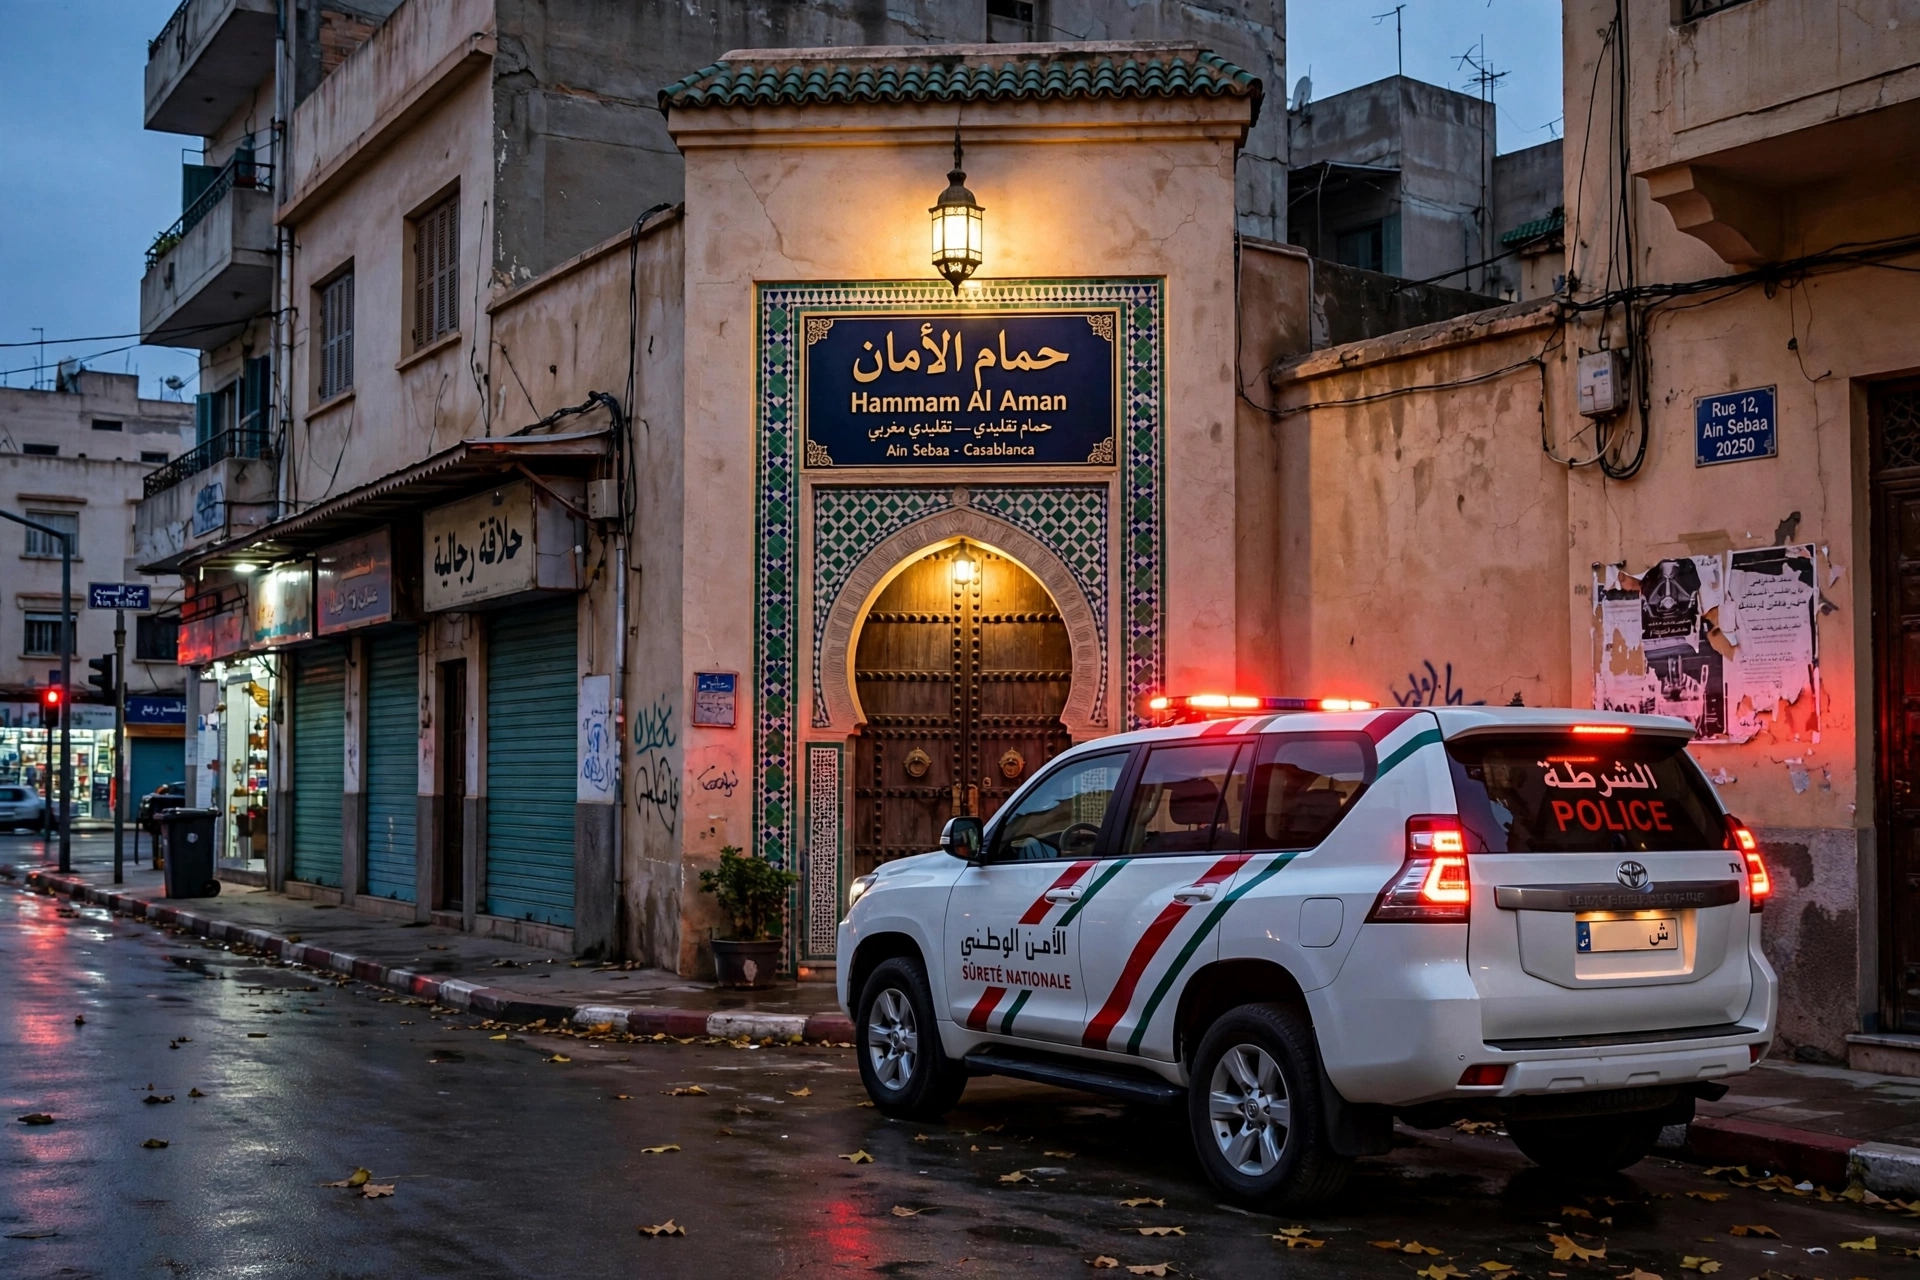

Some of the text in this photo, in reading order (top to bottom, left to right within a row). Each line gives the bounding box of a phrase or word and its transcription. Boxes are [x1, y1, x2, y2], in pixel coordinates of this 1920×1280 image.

[852, 322, 1070, 390] حمام الأمان
[851, 389, 1067, 413] Hammam Al Aman
[1712, 396, 1759, 418] Rue 12,
[868, 421, 905, 442] مغربي
[908, 419, 952, 439] تقليدي
[973, 418, 1017, 439] تقليدي
[1020, 418, 1052, 439] حمام
[1703, 417, 1768, 439] Ain Sebaa
[886, 444, 908, 457] Ain
[912, 443, 950, 457] Sebaa
[963, 442, 1035, 457] Casablanca
[1716, 437, 1755, 457] 20250
[479, 514, 523, 565] حلاقة
[434, 531, 475, 588] رجالية
[1537, 760, 1658, 797] الشرطة
[1551, 799, 1673, 832] POLICE
[961, 926, 1066, 962] الأمن الوطني
[1649, 922, 1669, 946] ش
[962, 961, 1072, 990] SÛRETÉ NATIONALE
